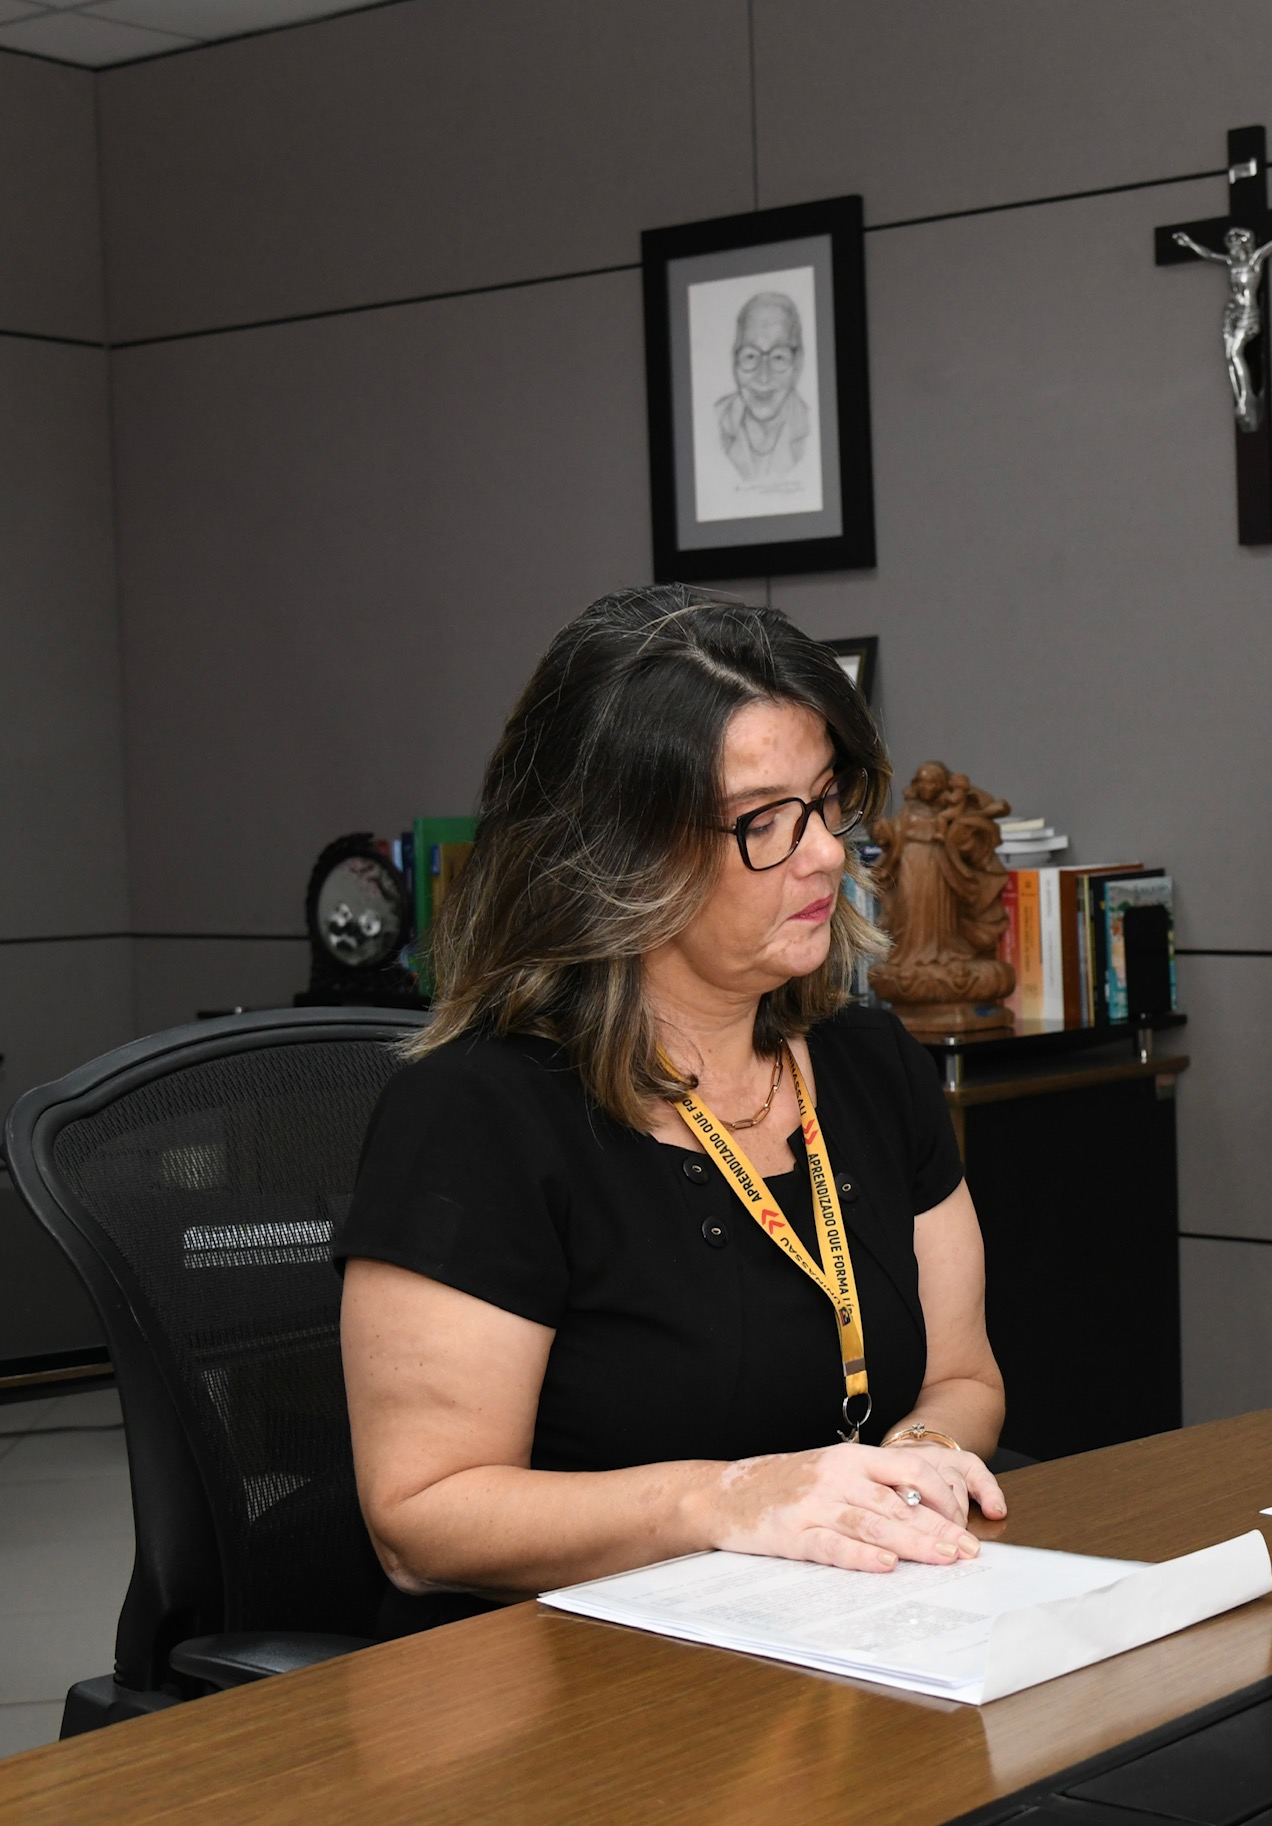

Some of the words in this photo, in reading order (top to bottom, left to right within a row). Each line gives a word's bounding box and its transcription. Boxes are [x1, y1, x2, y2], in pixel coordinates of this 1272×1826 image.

[682, 1098, 697, 1112] FO
[692, 1111, 714, 1133] QUE
[709, 1133, 762, 1203] APRENDIZADO
[808, 1153, 836, 1227] APRENDIZADO
[827, 1229, 842, 1253] QUE
[780, 1237, 841, 1304] UNINASSAU
[833, 1255, 849, 1295] FORMA
